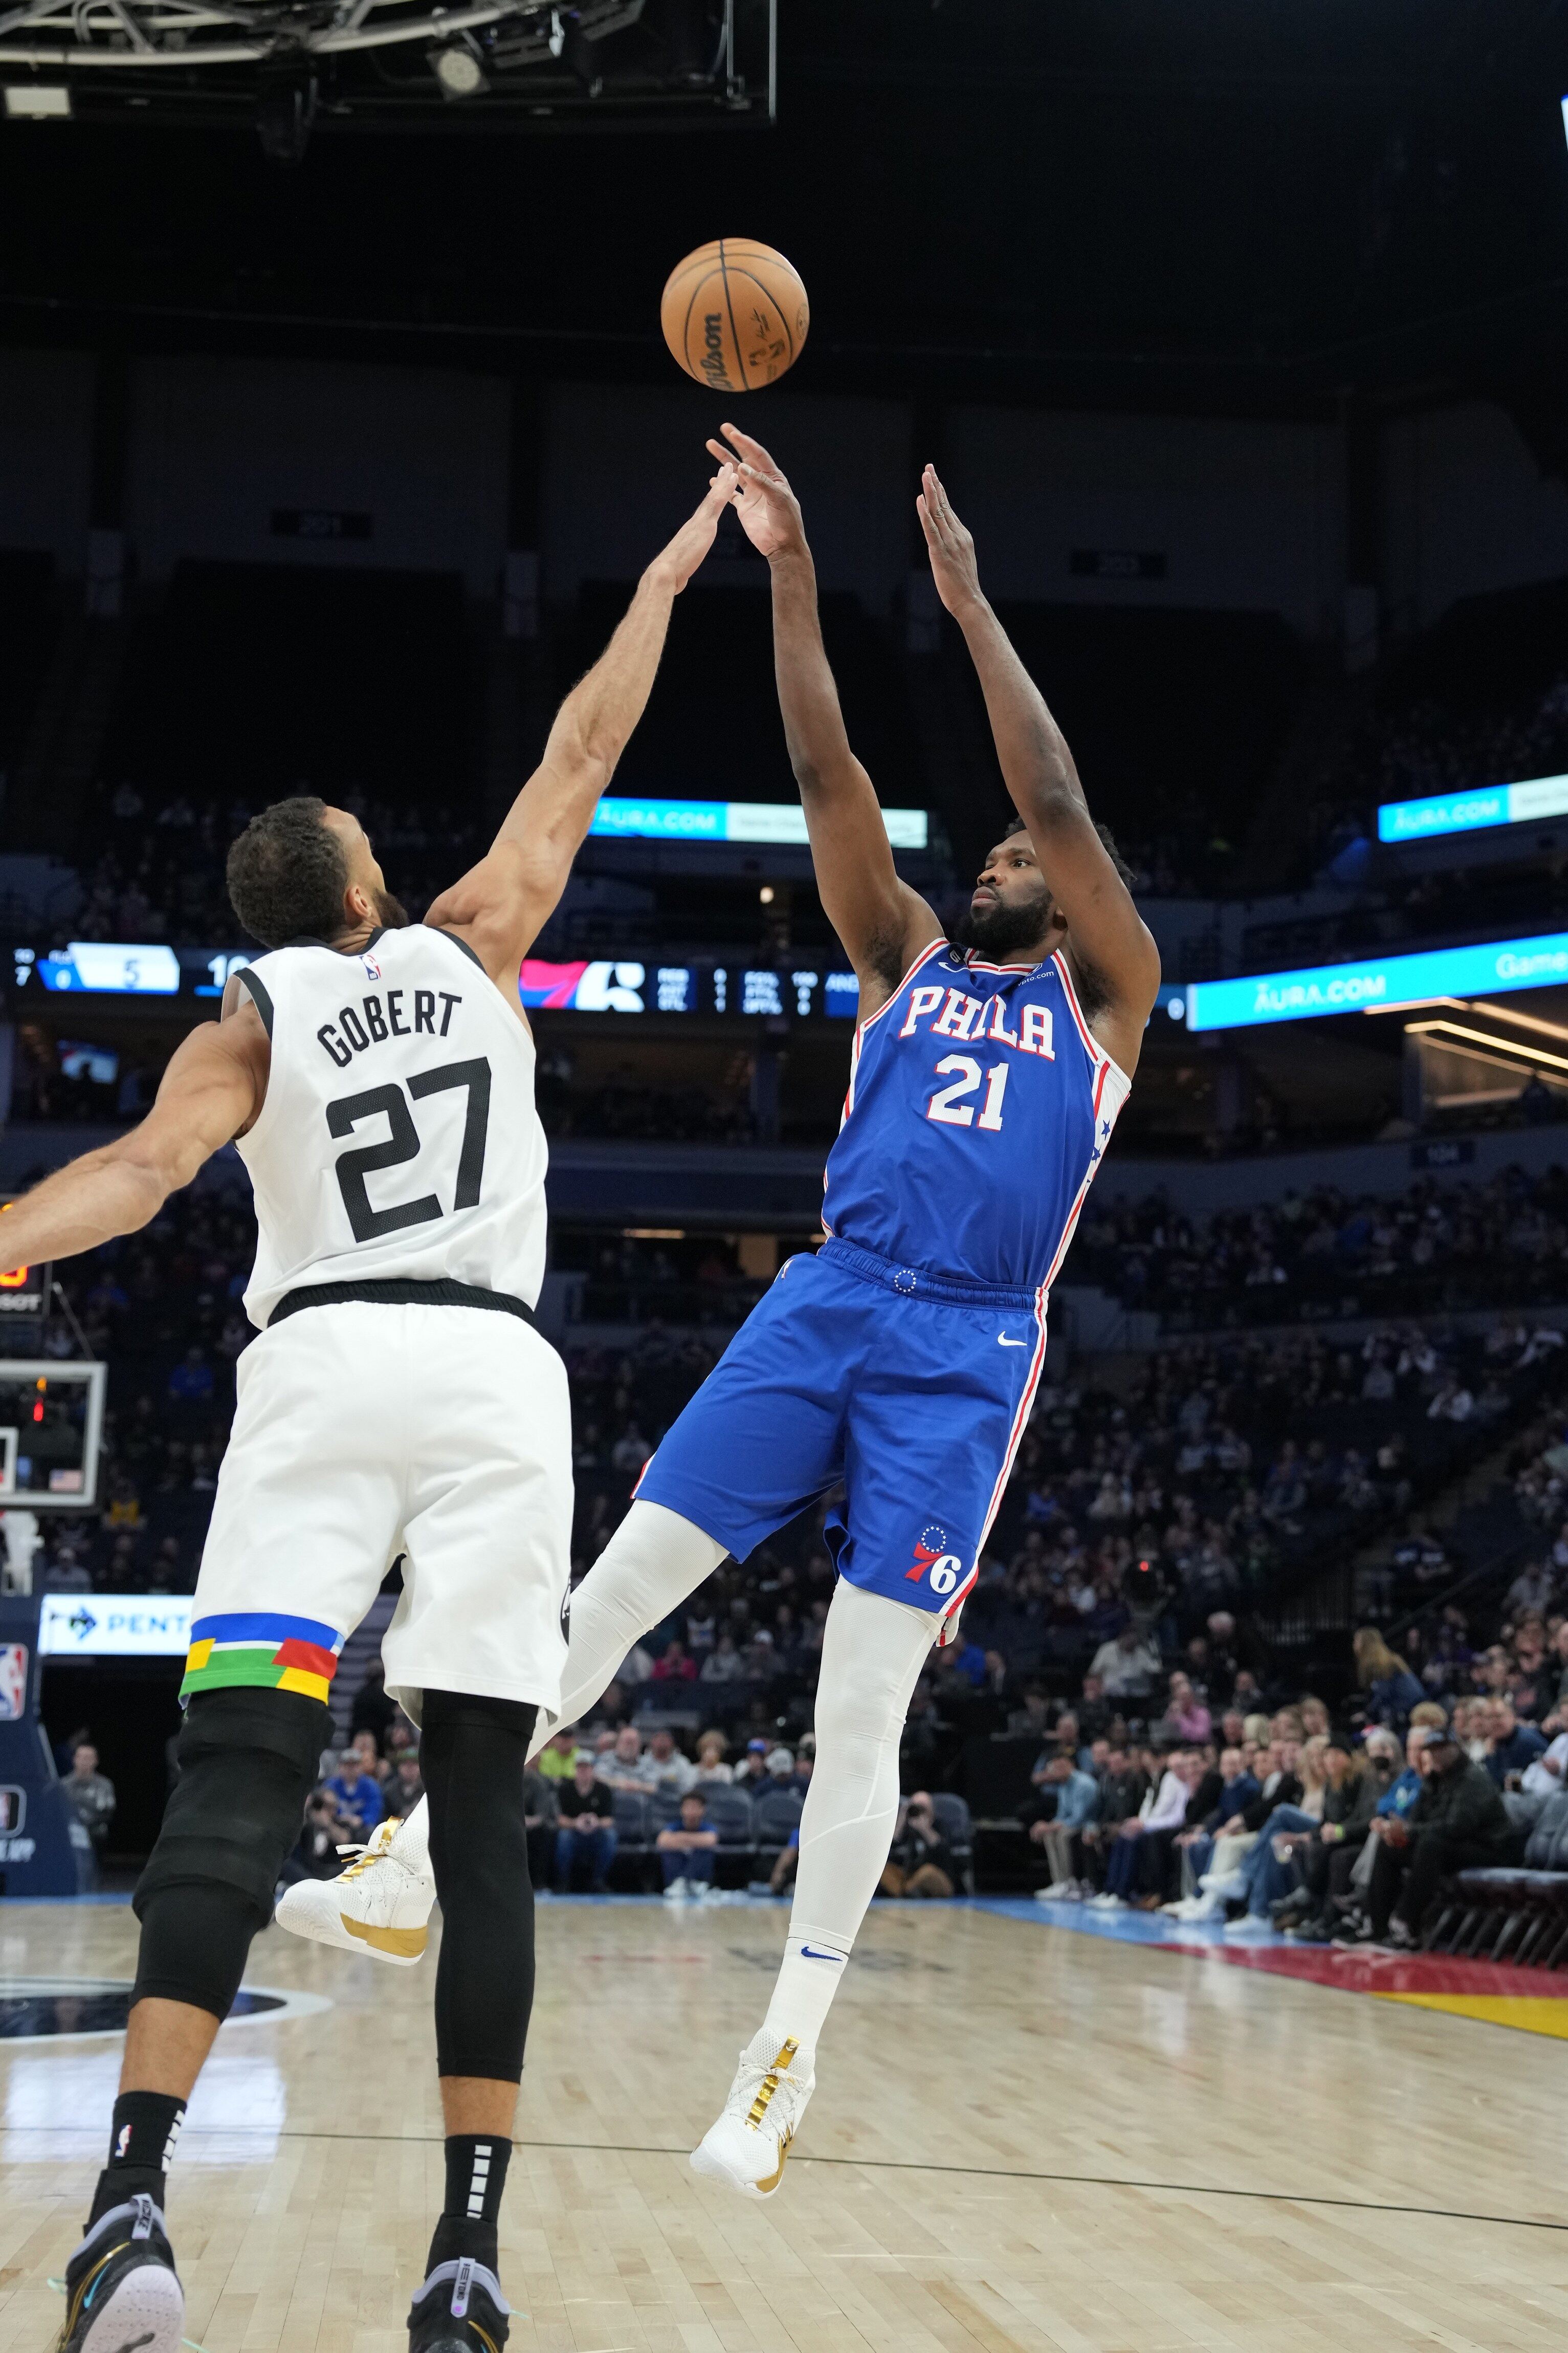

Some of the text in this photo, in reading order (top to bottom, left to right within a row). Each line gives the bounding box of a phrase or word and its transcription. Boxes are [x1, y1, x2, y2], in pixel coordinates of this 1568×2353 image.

[122, 959, 140, 988] 5
[317, 990, 462, 1067] GOBERT
[898, 986, 1055, 1061] PHILA
[926, 1054, 1009, 1131] 21
[325, 1056, 492, 1244] 27
[904, 1541, 962, 1594] 76
